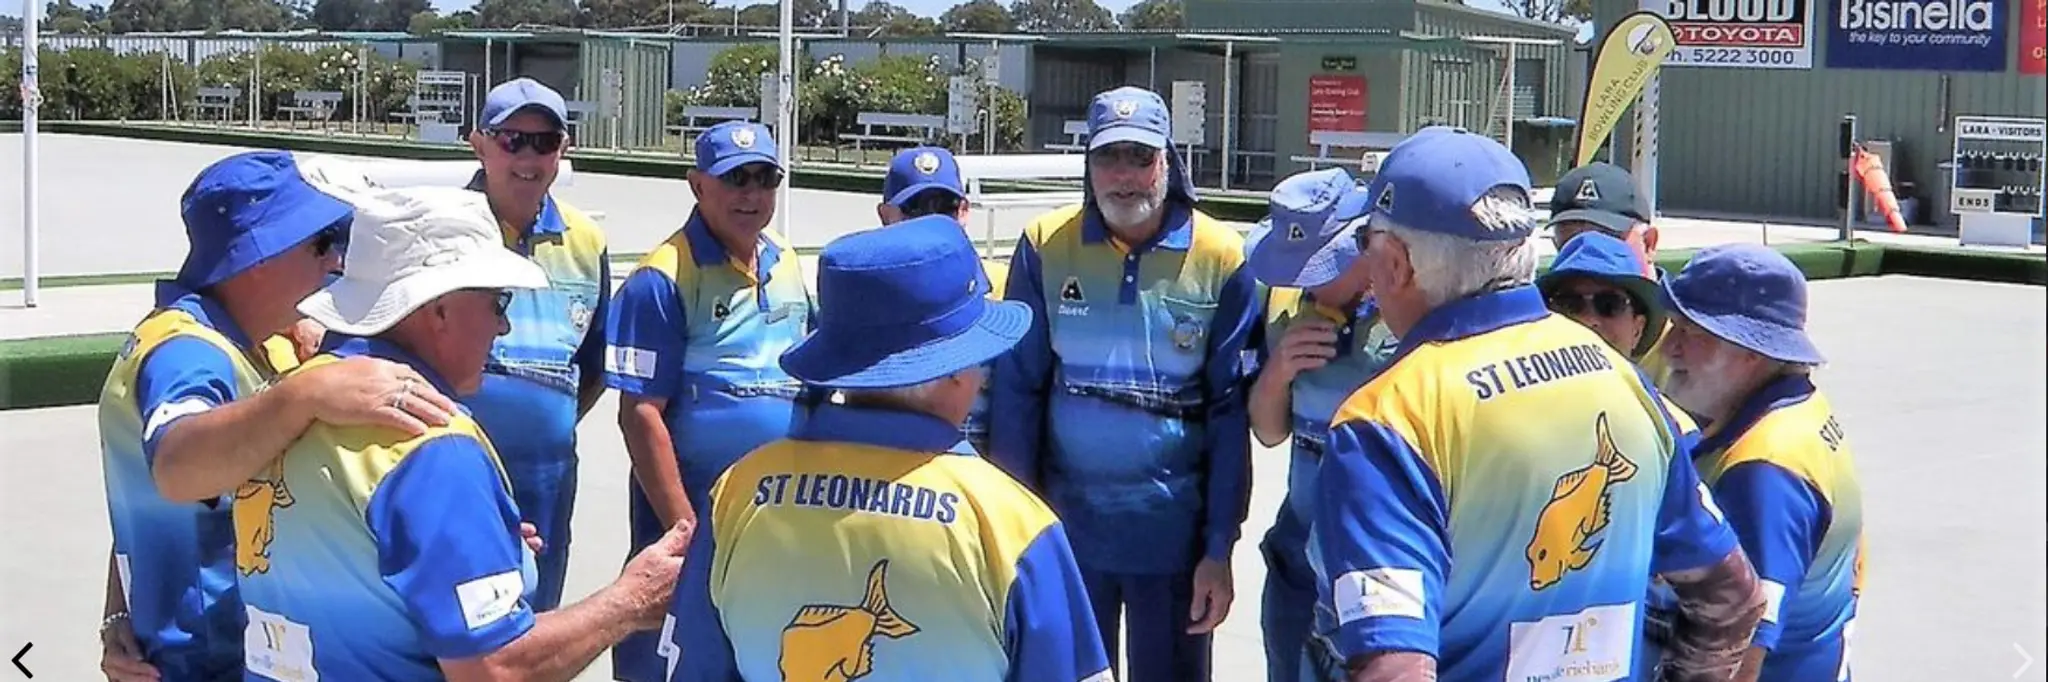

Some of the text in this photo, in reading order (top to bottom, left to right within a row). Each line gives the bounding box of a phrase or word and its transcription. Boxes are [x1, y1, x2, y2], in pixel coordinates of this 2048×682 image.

[1839, 0, 1994, 31] Bisinella
[1685, 27, 1795, 41] TOYOTA
[1849, 33, 1992, 48] the key to your community
[1665, 50, 1794, 64] h. 5222 3000
[1595, 77, 1620, 109] LARA
[1963, 125, 1990, 134] LARA
[1999, 127, 2041, 136] VISITORS
[1959, 197, 1989, 206] ENDS
[1466, 343, 1613, 400] ST LEONARDS
[754, 473, 960, 524] ST LEONARDS
